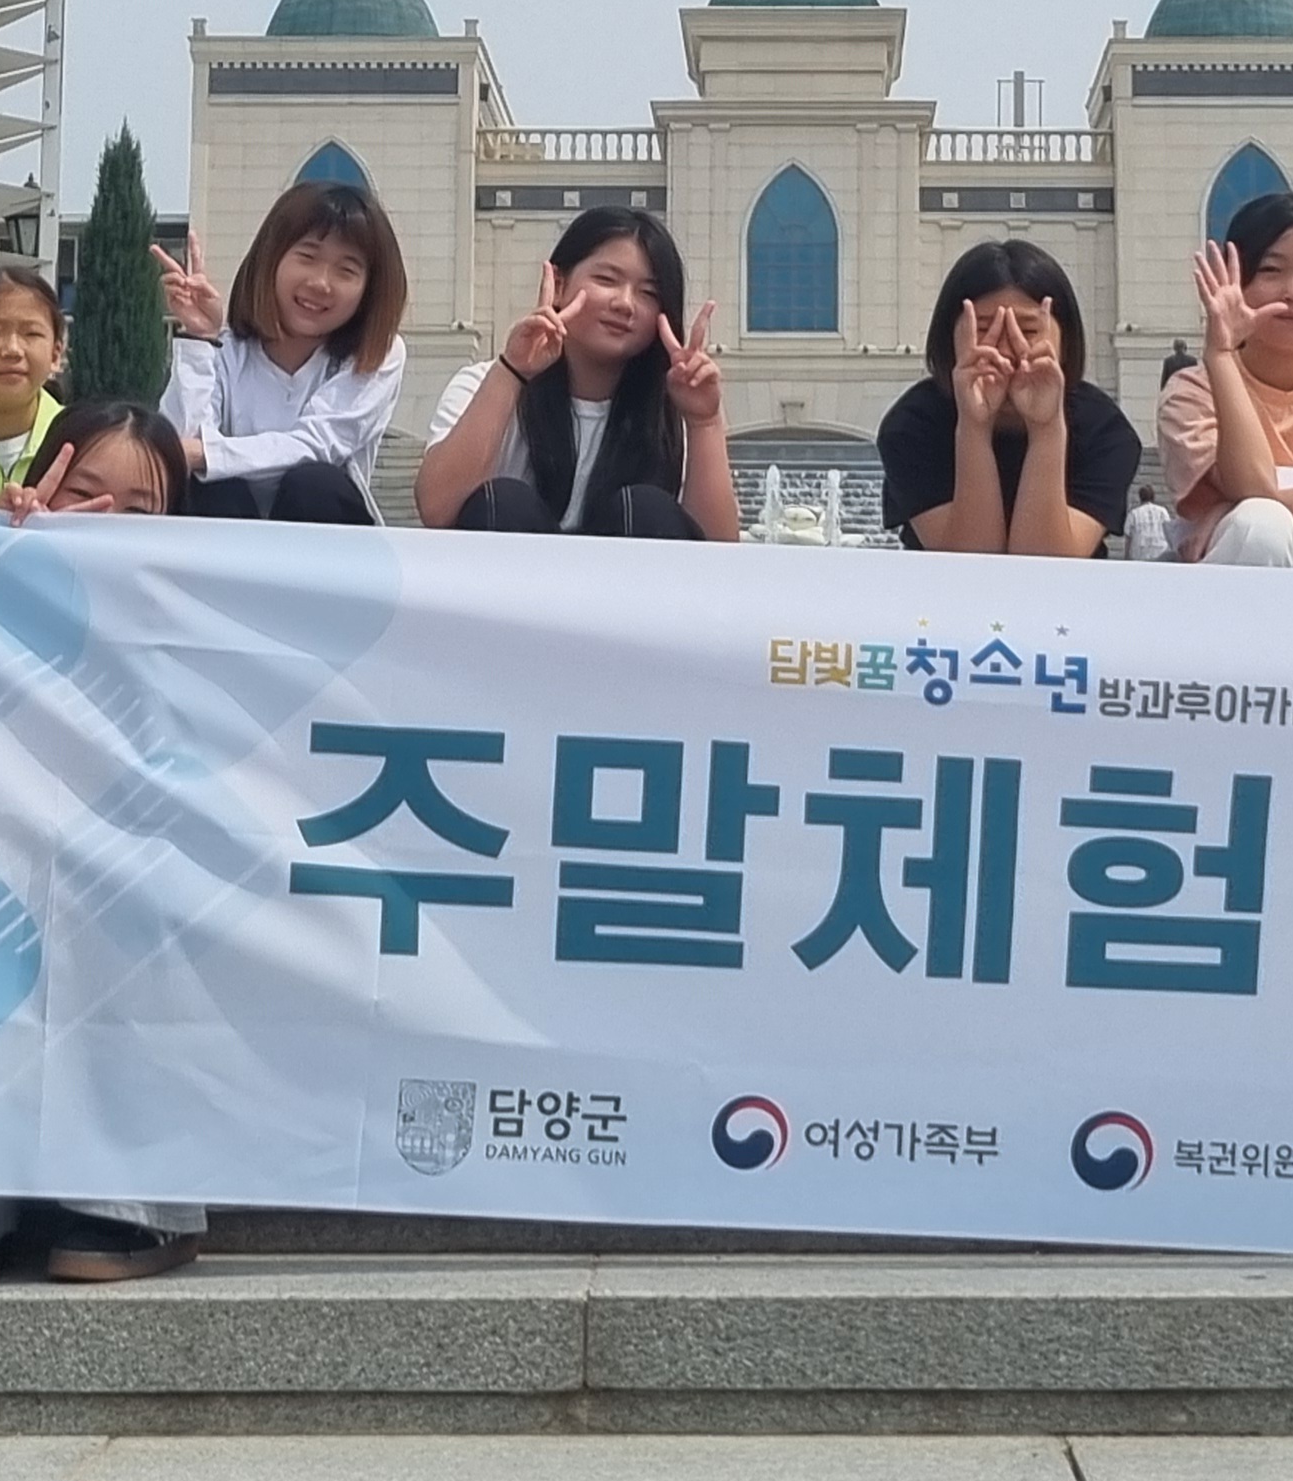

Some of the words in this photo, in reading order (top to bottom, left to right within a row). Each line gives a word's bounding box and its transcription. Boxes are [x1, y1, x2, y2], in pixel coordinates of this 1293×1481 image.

[489, 1088, 627, 1143] 담양군
[484, 1144, 581, 1163] DAMYANG
[587, 1148, 627, 1166] GUN
[804, 1118, 1001, 1165] 여성가족부
